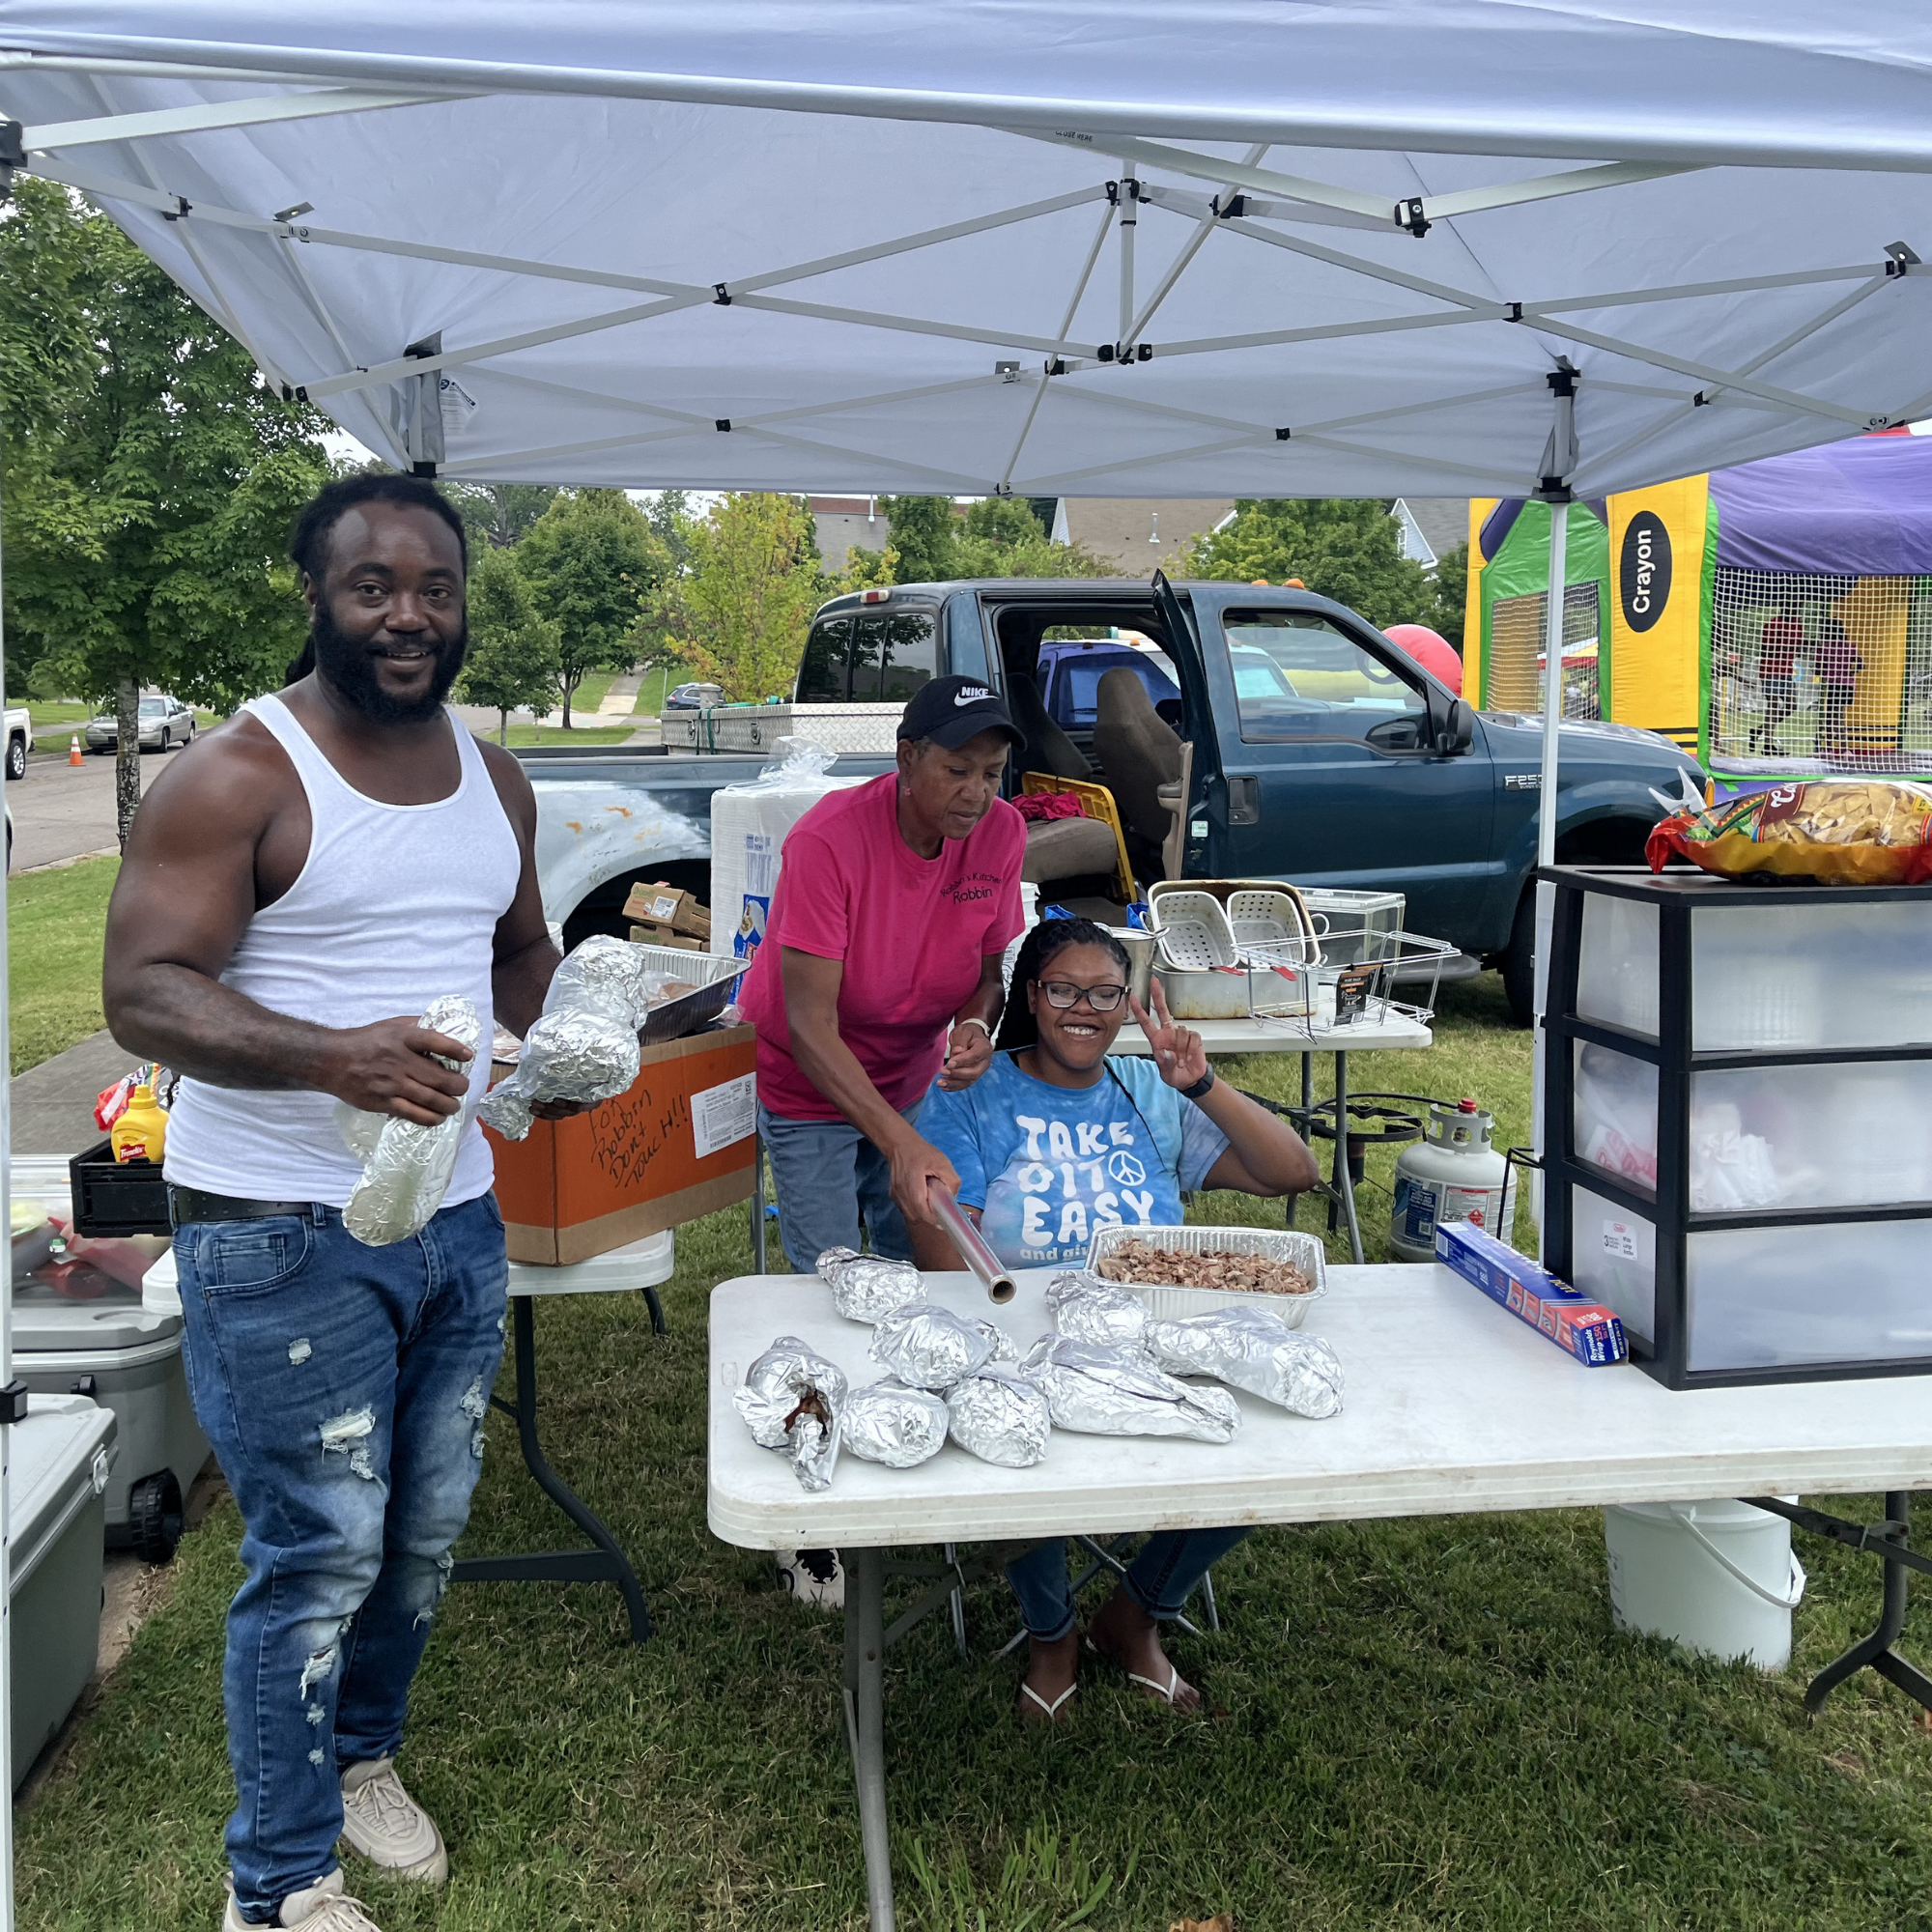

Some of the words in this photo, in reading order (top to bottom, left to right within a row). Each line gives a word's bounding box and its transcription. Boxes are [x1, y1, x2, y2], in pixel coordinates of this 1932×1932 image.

[1633, 529, 1657, 613] Crayon
[961, 687, 989, 696] NIKE
[952, 886, 993, 904] Robbin
[1016, 1115, 1135, 1160] TAKE
[1021, 1189, 1154, 1247] EASY
[1020, 1247, 1059, 1261] and
[1593, 1326, 1604, 1342] 150
[1585, 1328, 1598, 1361] Reynolds
[1596, 1342, 1605, 1361] Wrap
